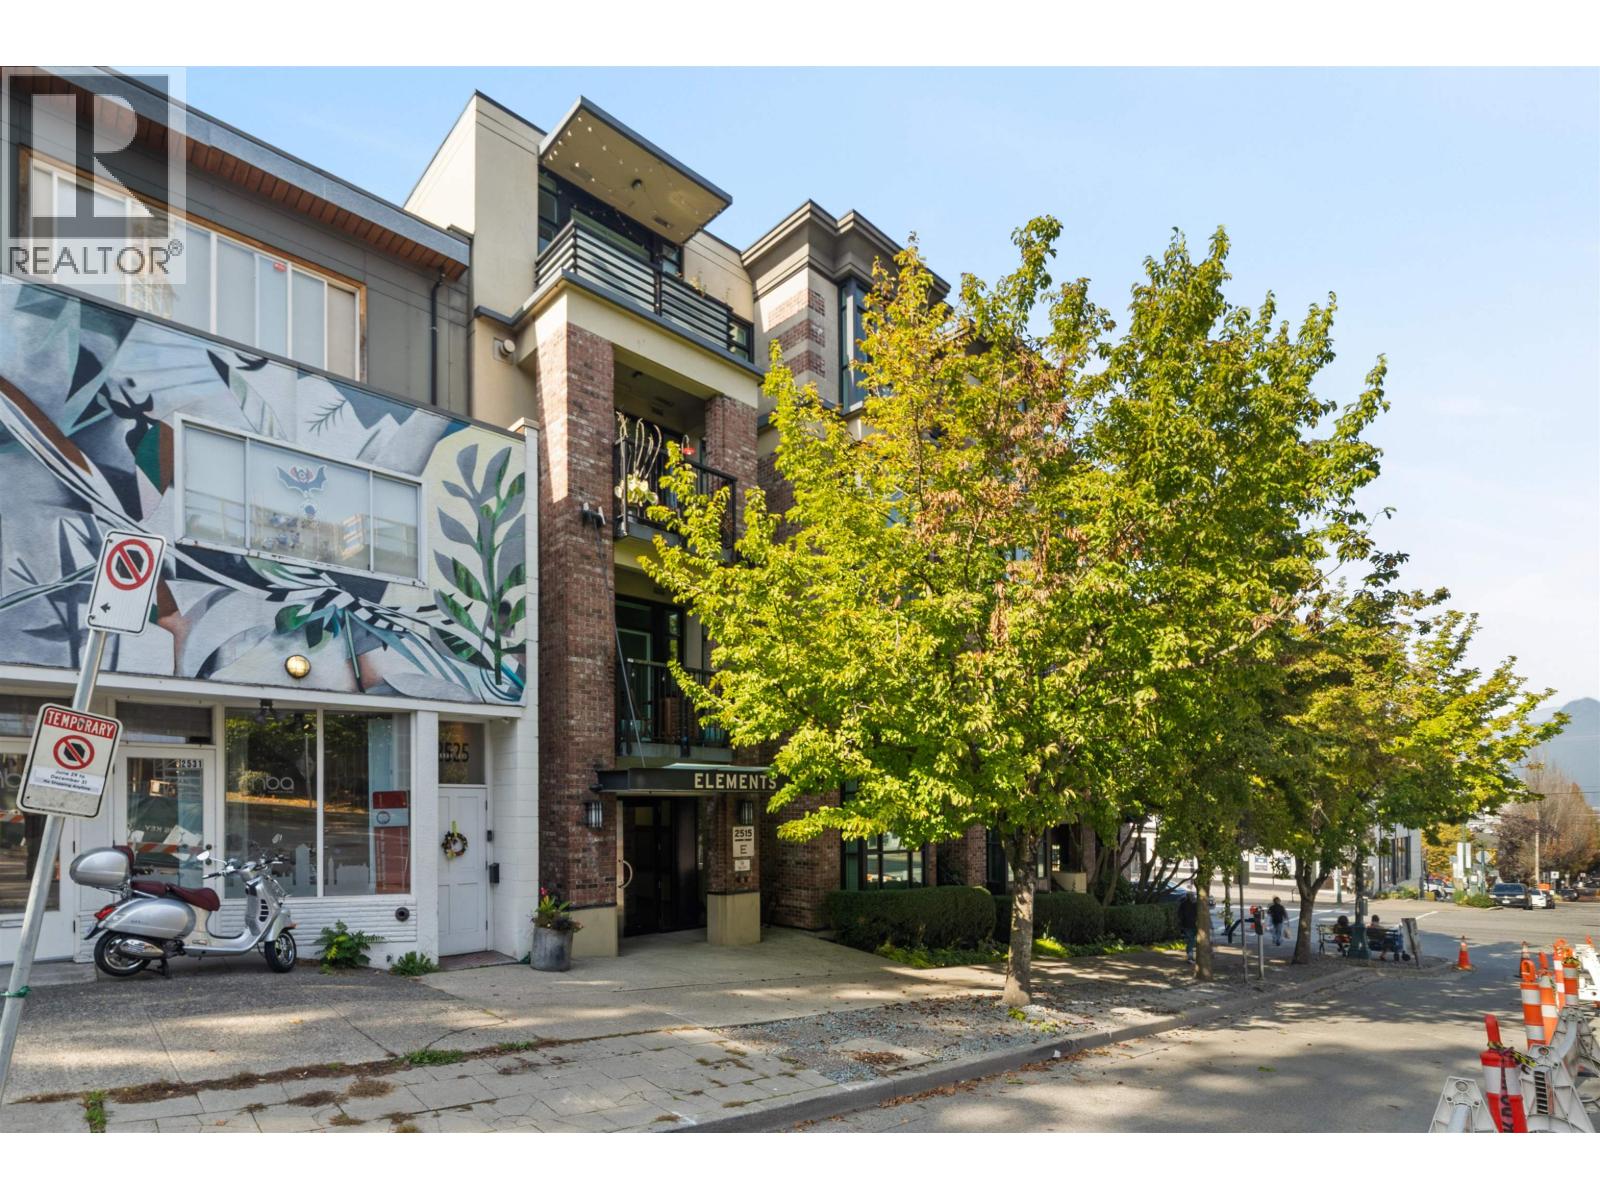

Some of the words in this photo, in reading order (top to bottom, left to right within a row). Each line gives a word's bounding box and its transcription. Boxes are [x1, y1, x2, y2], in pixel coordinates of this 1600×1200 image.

[48, 711, 113, 737] TEMPORARY
[694, 772, 777, 790] ELEMENTS
[734, 829, 752, 838] 2515
[740, 844, 748, 855] E
